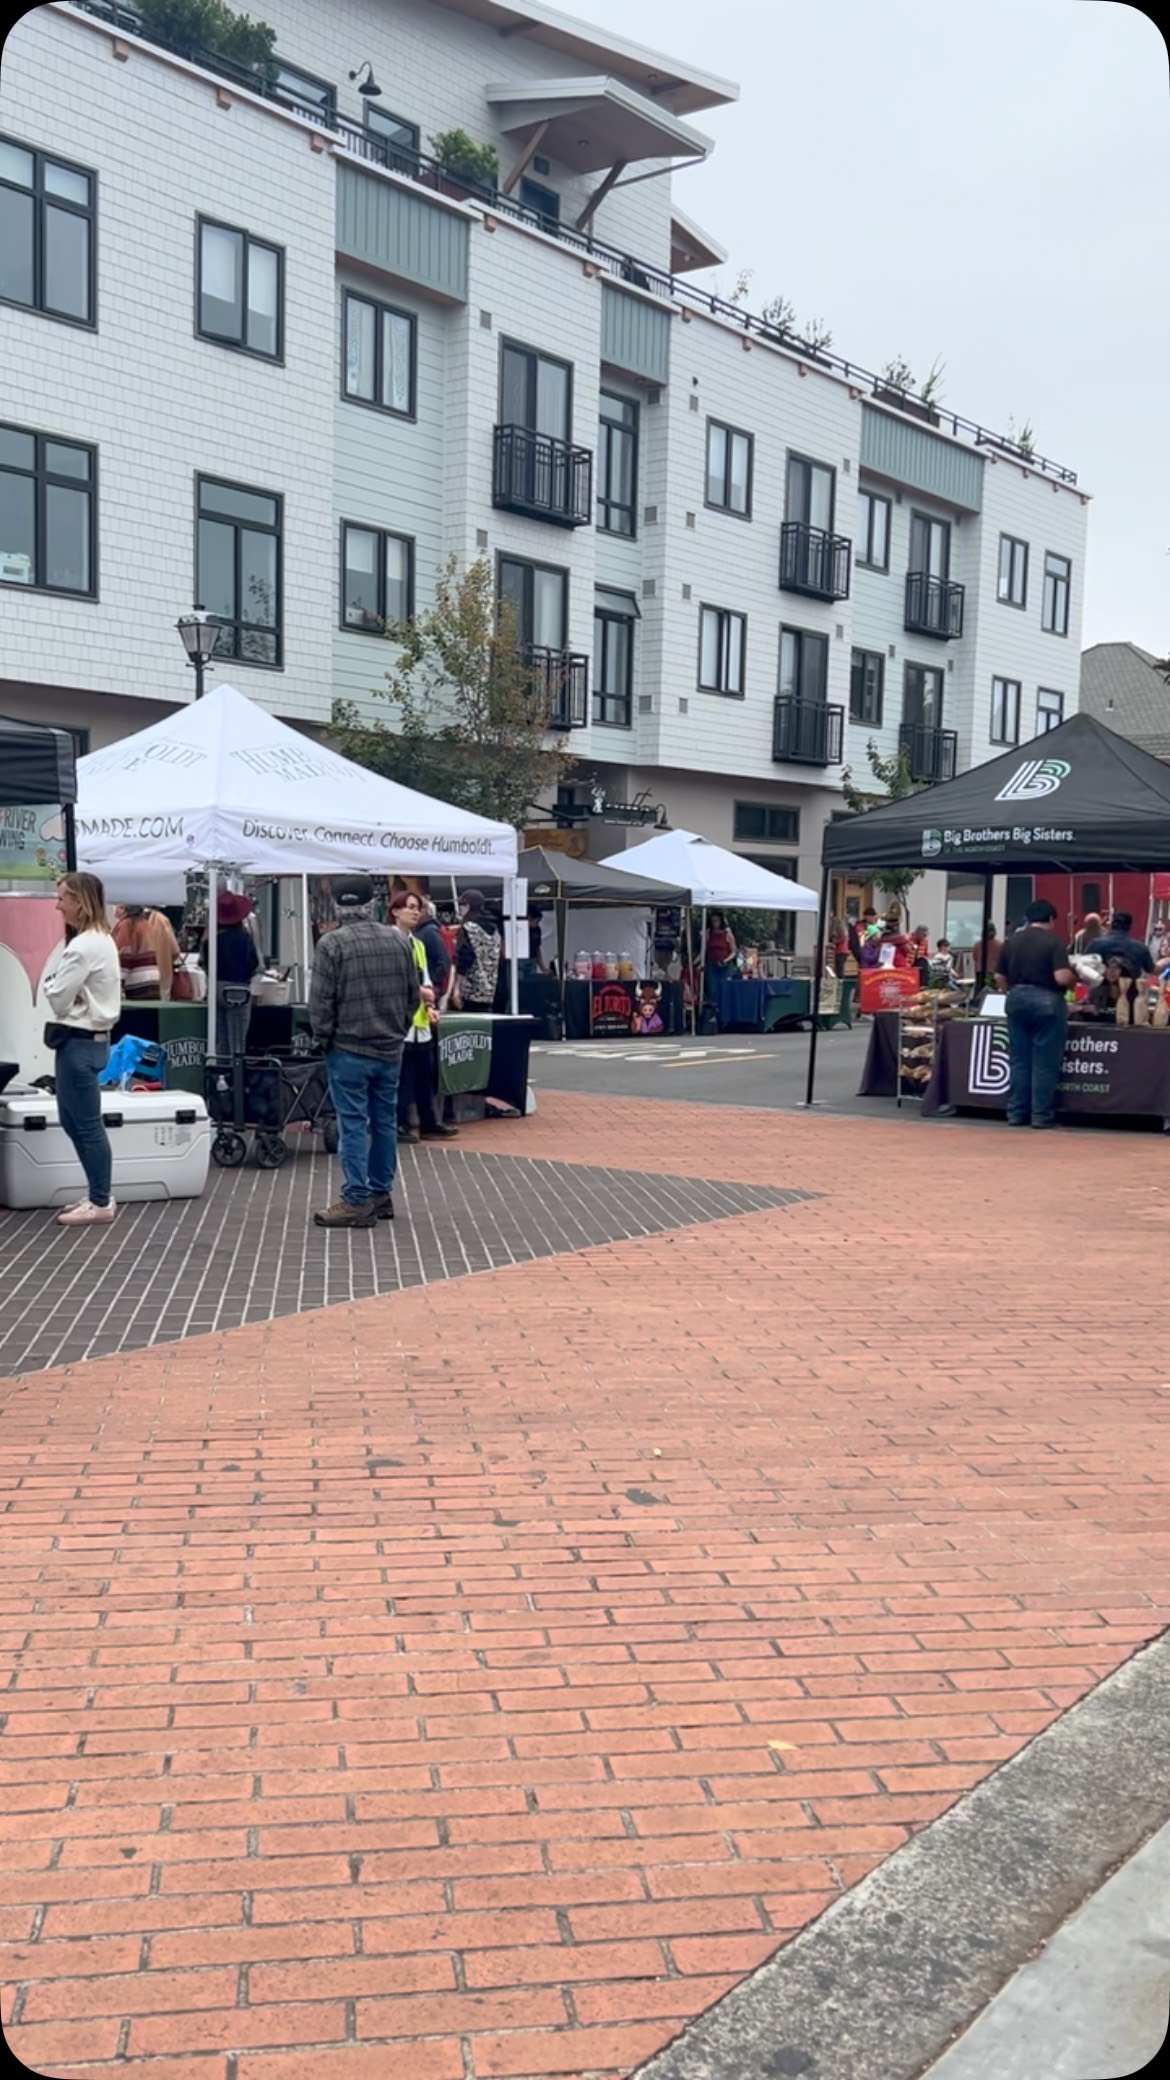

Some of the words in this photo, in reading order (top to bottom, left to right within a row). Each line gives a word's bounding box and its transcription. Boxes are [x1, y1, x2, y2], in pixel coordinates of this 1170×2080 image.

[5, 808, 37, 834] RIVER
[243, 819, 312, 842] Discover.
[314, 826, 377, 848] Connect.
[380, 832, 429, 851] Choose
[431, 836, 496, 856] Humboldt.
[944, 830, 961, 846] Big
[963, 828, 1010, 842] Brothers
[1013, 827, 1032, 844] Big
[1033, 826, 1076, 841] Sisters.
[439, 1034, 492, 1062] HUMBOLDT
[1065, 1036, 1118, 1053] rothers
[171, 1053, 203, 1069] MADE
[447, 1049, 475, 1067] MADE
[1062, 1057, 1109, 1075] isters.
[1082, 1082, 1111, 1093] COAST
